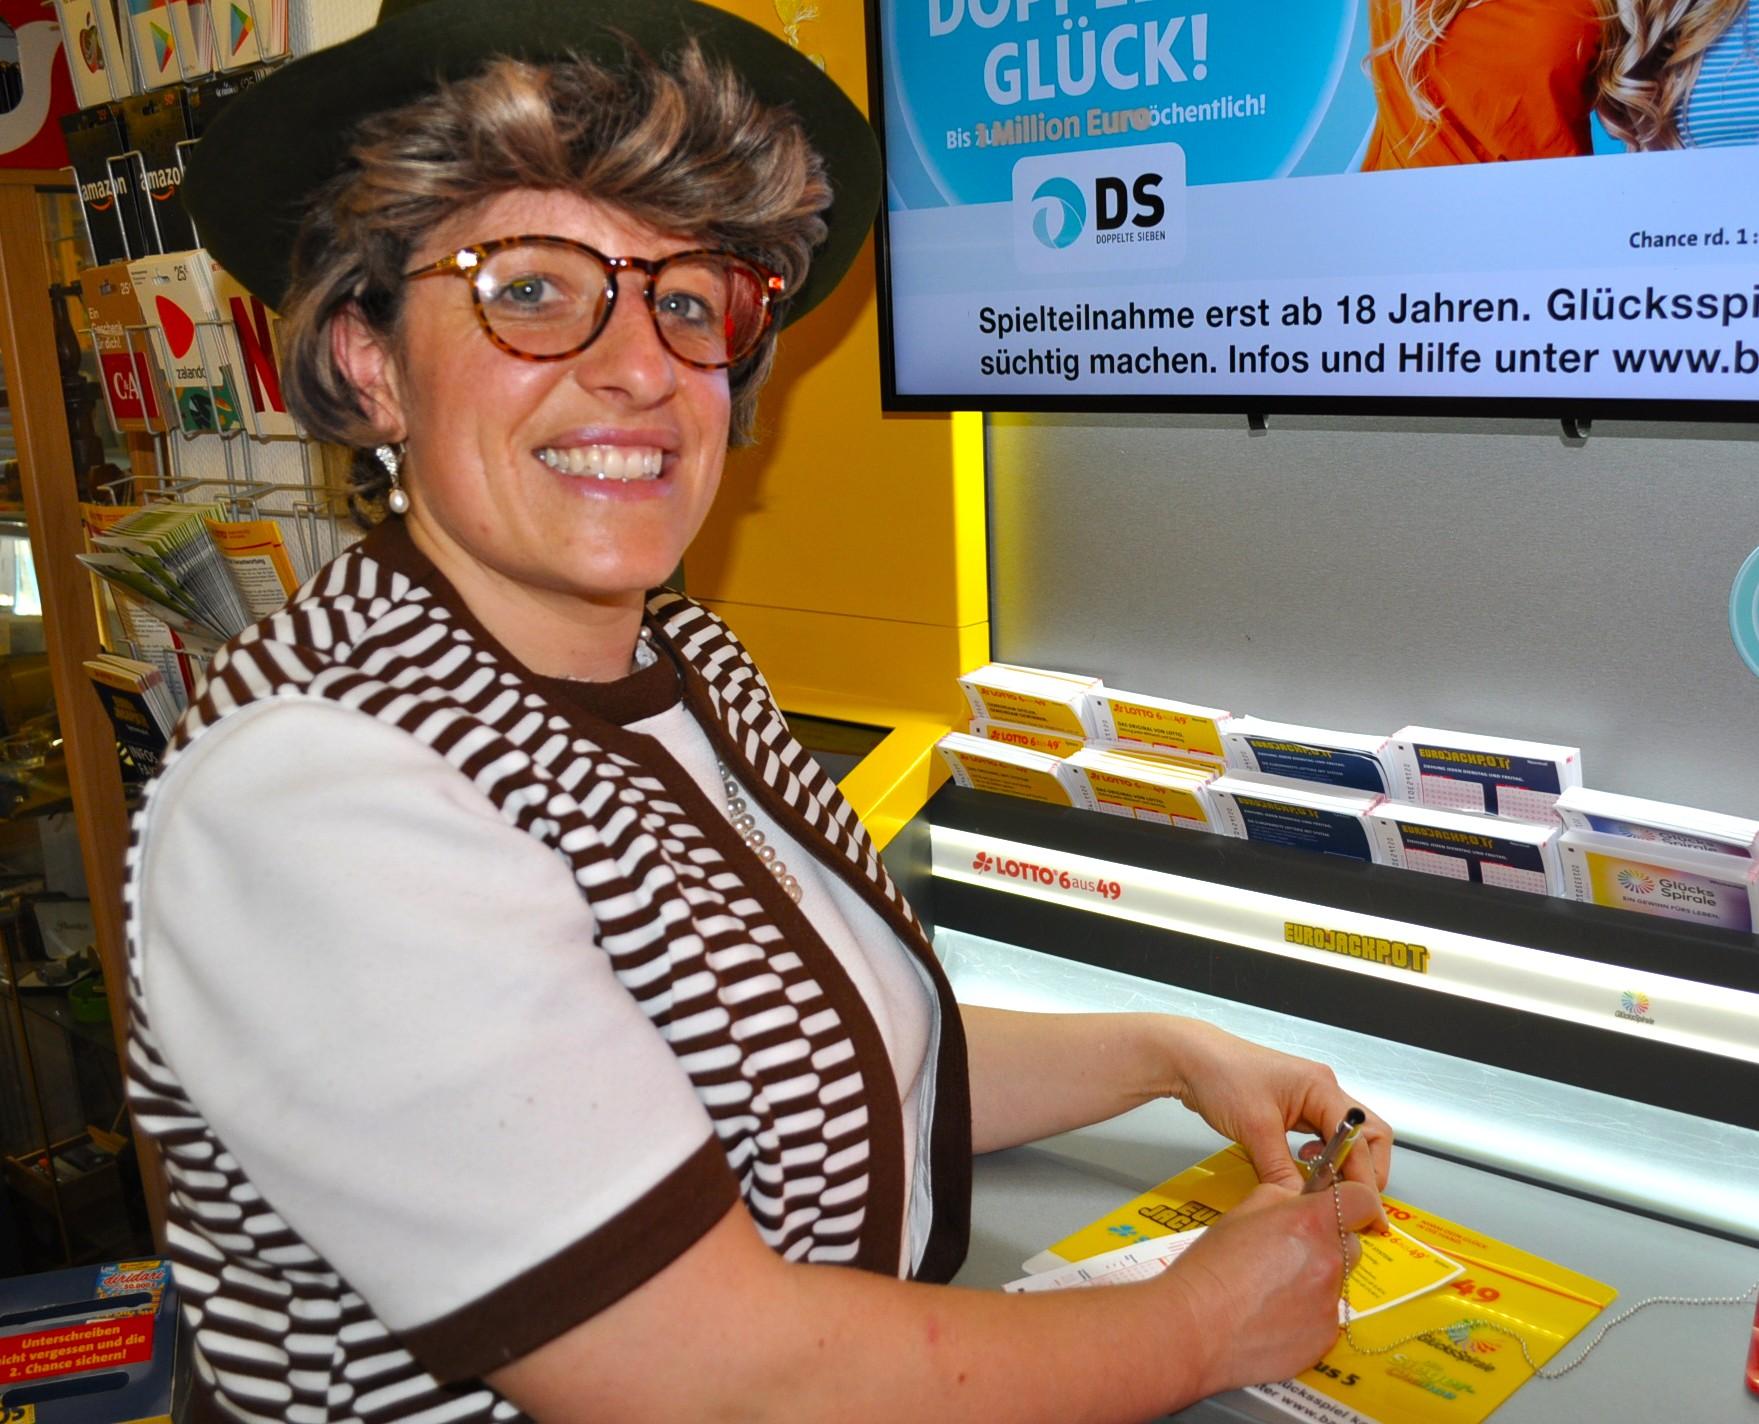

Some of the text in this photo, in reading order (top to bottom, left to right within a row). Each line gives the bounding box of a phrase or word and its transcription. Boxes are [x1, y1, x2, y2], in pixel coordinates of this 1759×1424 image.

[983, 13, 1208, 105] GLÜCK!
[945, 128, 971, 149] Bis
[1149, 94, 1266, 127] öchentlich!
[992, 112, 1081, 147] Million
[1087, 107, 1152, 137] Euro
[140, 165, 184, 192] amazo
[1094, 173, 1166, 231] DS
[1096, 230, 1166, 244] DOPPELTE SIEBEN
[1629, 229, 1699, 249] Chance
[1704, 228, 1730, 246] rd.
[979, 303, 1195, 339] Spielteilnahme
[1206, 301, 1269, 327] erst
[1282, 298, 1322, 325] ab
[1337, 295, 1376, 323] 18
[1388, 293, 1530, 325] Jahren.
[980, 348, 1080, 381] süchtig
[1090, 345, 1217, 375] machen.
[1229, 344, 1309, 374] Infos
[1321, 342, 1385, 373] und
[1399, 341, 1481, 373] Hilfe
[1495, 344, 1599, 373] unter
[1002, 732, 1028, 745] LOTTO
[1419, 748, 1511, 770] EUROJACKPOT
[1659, 878, 1715, 898] Glücks
[1661, 887, 1717, 907] Spirale
[1284, 921, 1429, 973] EUROJACKPOT
[0, 1334, 146, 1366] icht vergessen und die
[22, 1326, 121, 1349] Unterschreiben
[9, 1348, 127, 1377] 2. Chance sichern!
